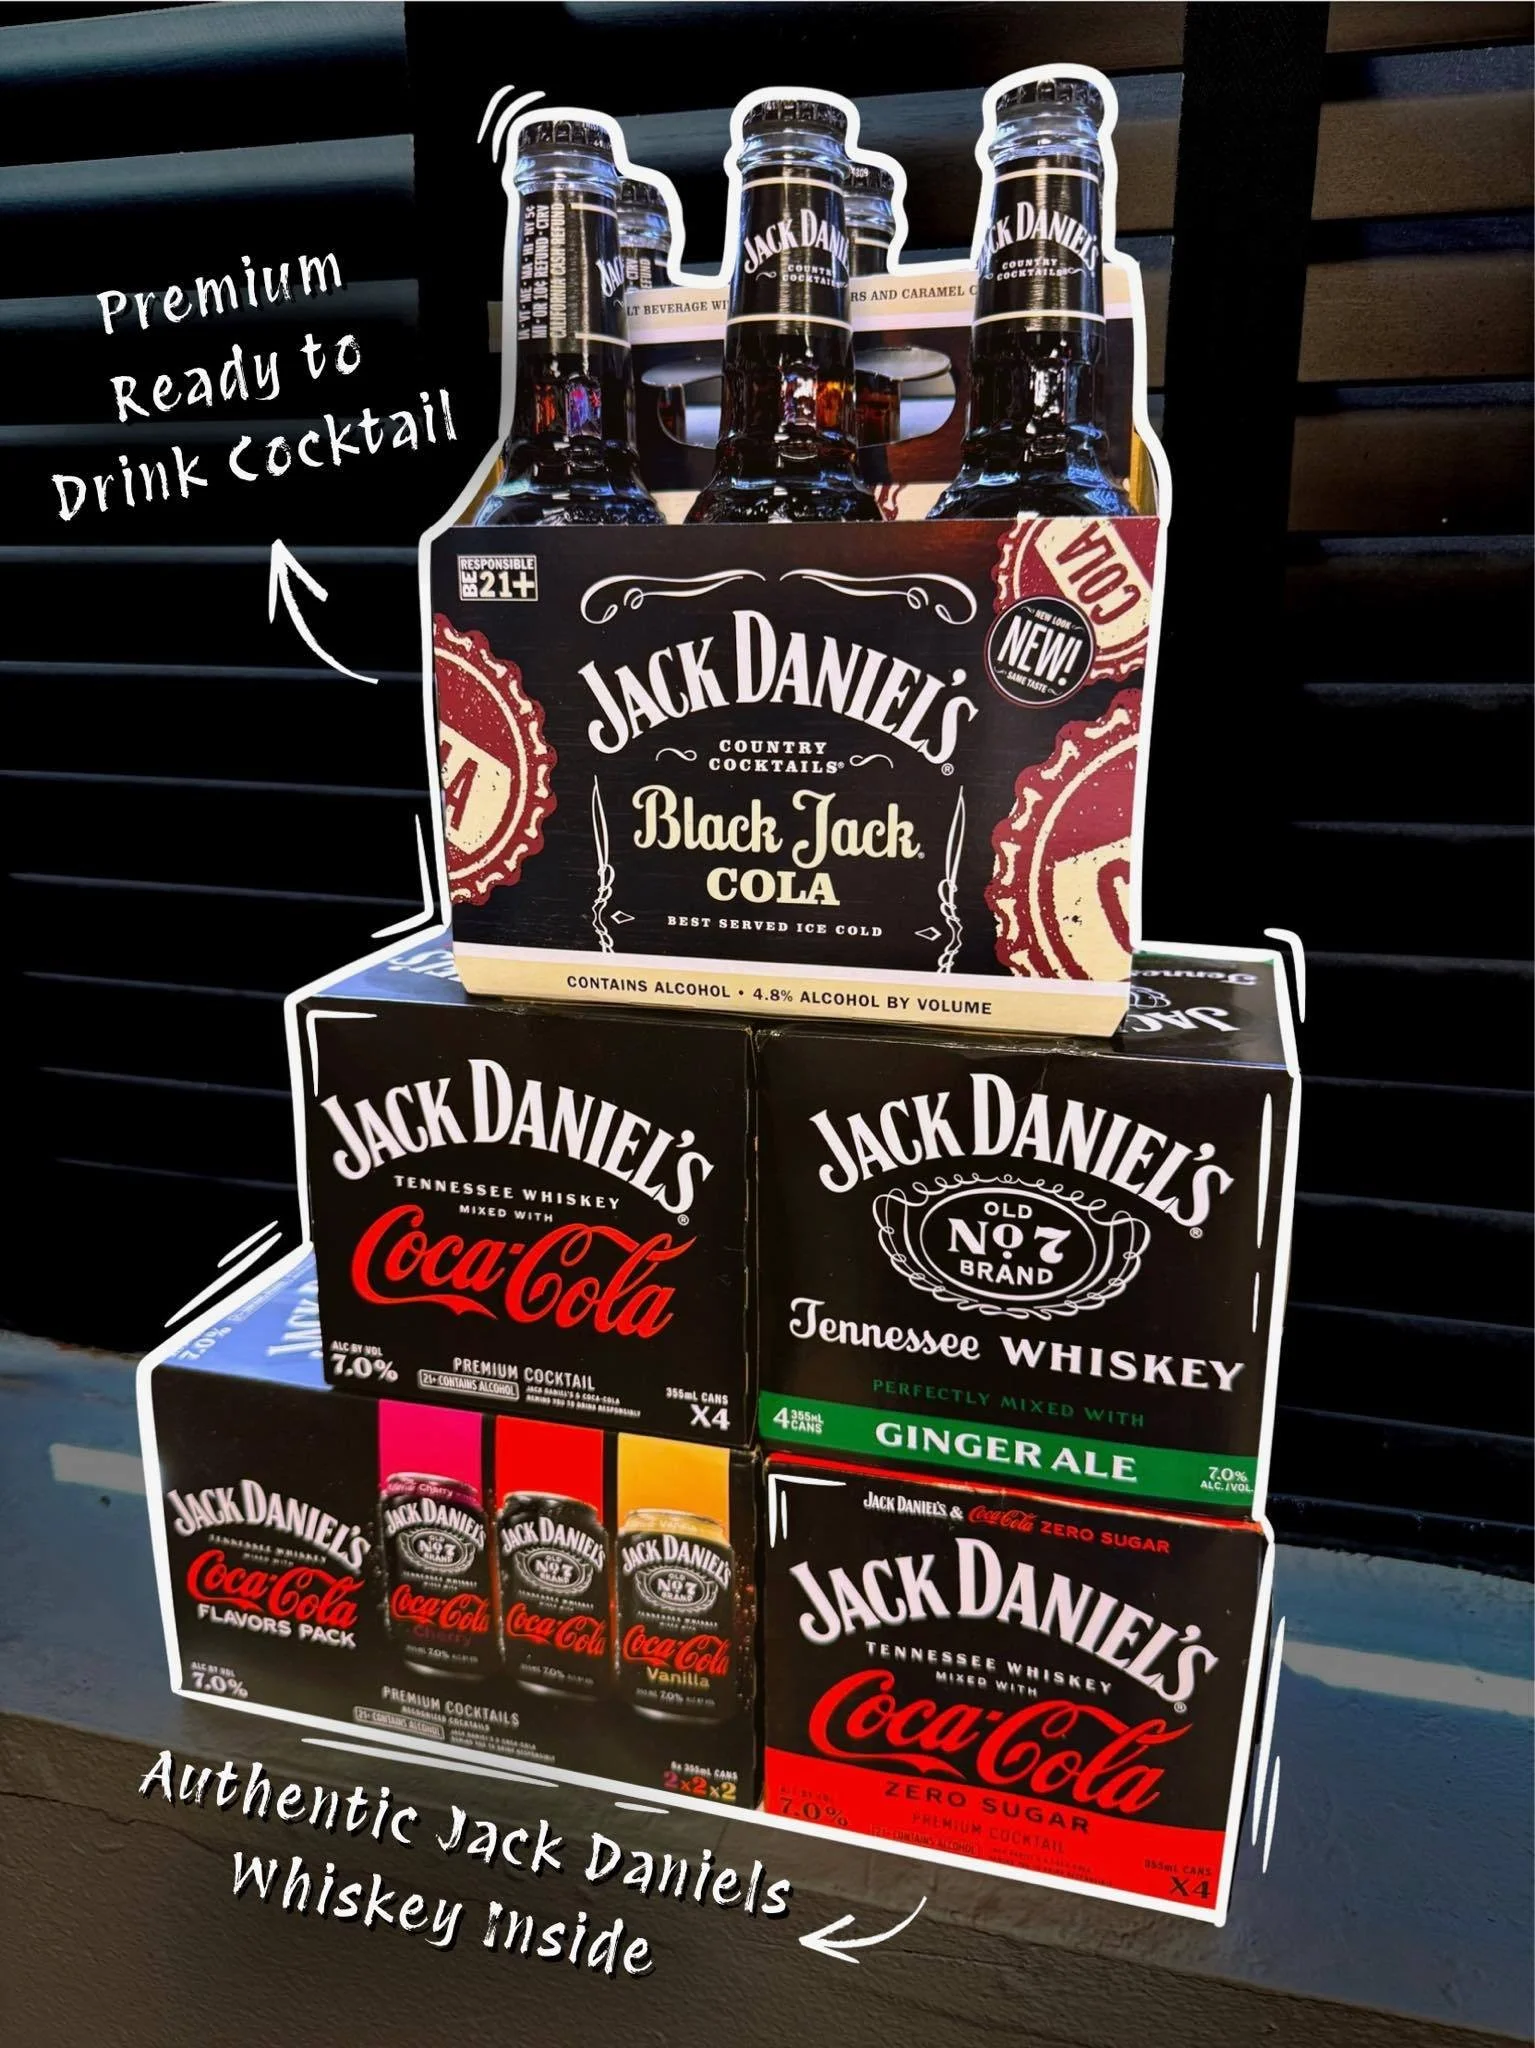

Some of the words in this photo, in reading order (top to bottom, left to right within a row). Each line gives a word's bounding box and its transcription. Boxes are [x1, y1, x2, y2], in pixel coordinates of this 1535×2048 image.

[550, 203, 566, 245] REFUND
[535, 237, 549, 278] REFUND
[549, 248, 566, 276] CASH
[744, 219, 799, 274] JACK
[1002, 258, 1058, 270] COUNTRY
[533, 303, 548, 317] OR
[549, 278, 566, 339] CALIFORNIA
[644, 301, 709, 315] BEVERAGE
[871, 290, 897, 301] AND
[902, 286, 964, 299] CARAMEL
[461, 558, 535, 570] RESPONSIBLE
[1056, 520, 1142, 625] COLA
[461, 571, 478, 597] BE
[479, 571, 535, 598] 21+
[997, 615, 1083, 686] NEW!
[578, 636, 729, 754] JACK
[732, 609, 979, 764] DANIEL'S
[719, 739, 828, 755] COUNTRY
[632, 784, 783, 852] Black
[791, 788, 919, 869] Jack
[706, 867, 840, 906] COLA
[667, 915, 711, 928] BEST
[719, 918, 788, 932] SERVED
[796, 923, 828, 934] ICE
[835, 925, 883, 937] COLD
[567, 975, 648, 992] CONTAINS
[655, 981, 731, 998] ALCOHOL
[752, 988, 793, 1001] 4.8%
[800, 992, 880, 1008] ALCOHOL
[887, 996, 910, 1009] BY
[917, 998, 992, 1014] VOLUME
[320, 1077, 469, 1181] JACK
[467, 1058, 715, 1214] DANIEL'S
[809, 1091, 966, 1194] JACK
[970, 1072, 1235, 1227] DANIEL'S
[394, 1175, 514, 1199] TENNESSEE
[522, 1188, 620, 1211] WHISKEY
[984, 1200, 1033, 1220] OLD
[459, 1204, 506, 1219] MIXED
[514, 1209, 554, 1223] WITH
[352, 1204, 697, 1338] Coca-Cola
[959, 1259, 1054, 1285] BRAND
[788, 1297, 981, 1361] Tennessee
[999, 1335, 1246, 1392] WHISKEY
[331, 1352, 399, 1383] 7.0%
[440, 1374, 478, 1391] CONTAINS
[479, 1381, 516, 1396] ALCOHOL
[452, 1357, 519, 1380] PREMIUM
[523, 1366, 596, 1391] COCKTAIL
[701, 1391, 729, 1406] CANS
[872, 1378, 989, 1408] PERFECTLY
[1000, 1395, 1075, 1419] MIXED
[1084, 1406, 1145, 1428] WITH
[690, 1403, 731, 1431] X4
[773, 1407, 790, 1429] 4
[791, 1420, 823, 1435] CANS
[874, 1422, 1042, 1469] GINGER
[1050, 1447, 1138, 1484] ALE
[1208, 1466, 1248, 1482] 7.0%
[167, 1487, 245, 1537] JACK
[240, 1479, 372, 1573] DANIEL'S
[385, 1502, 422, 1537] JACK
[863, 1491, 895, 1512] JACK
[897, 1495, 948, 1518] DANIEL'S
[949, 1504, 964, 1520] &
[967, 1504, 1038, 1533] Coca-Cola
[1040, 1521, 1095, 1541] ZERO
[1100, 1531, 1171, 1554] SUGAR
[501, 1521, 539, 1556] JACK
[622, 1539, 662, 1576] JACK
[185, 1548, 365, 1630] Coca-Cola
[196, 1603, 292, 1637] FLAVORS
[299, 1622, 357, 1649] PACK
[789, 1553, 950, 1644] JACK
[953, 1536, 1220, 1702] DANIEL'S
[192, 1671, 248, 1699] 7.0%
[646, 1665, 710, 1688] Vanilla
[866, 1641, 997, 1672] TENNESSEE
[1006, 1660, 1113, 1696] WHISKEY
[935, 1670, 988, 1690] MIXED
[995, 1680, 1039, 1697] WITH
[381, 1685, 440, 1711] PREMIUM
[445, 1700, 520, 1729] COCKTAILS
[809, 1668, 1194, 1815] Coca-Cola
[714, 1768, 738, 1781] CANS
[780, 1796, 849, 1827] 7.0%
[886, 1781, 967, 1808] ZERO
[982, 1796, 1091, 1835] SUGAR
[912, 1812, 982, 1834] PREMIUM
[990, 1826, 1064, 1853] COCKTAIL
[1169, 1876, 1211, 1899] X4
[1183, 1864, 1212, 1876] CANS
